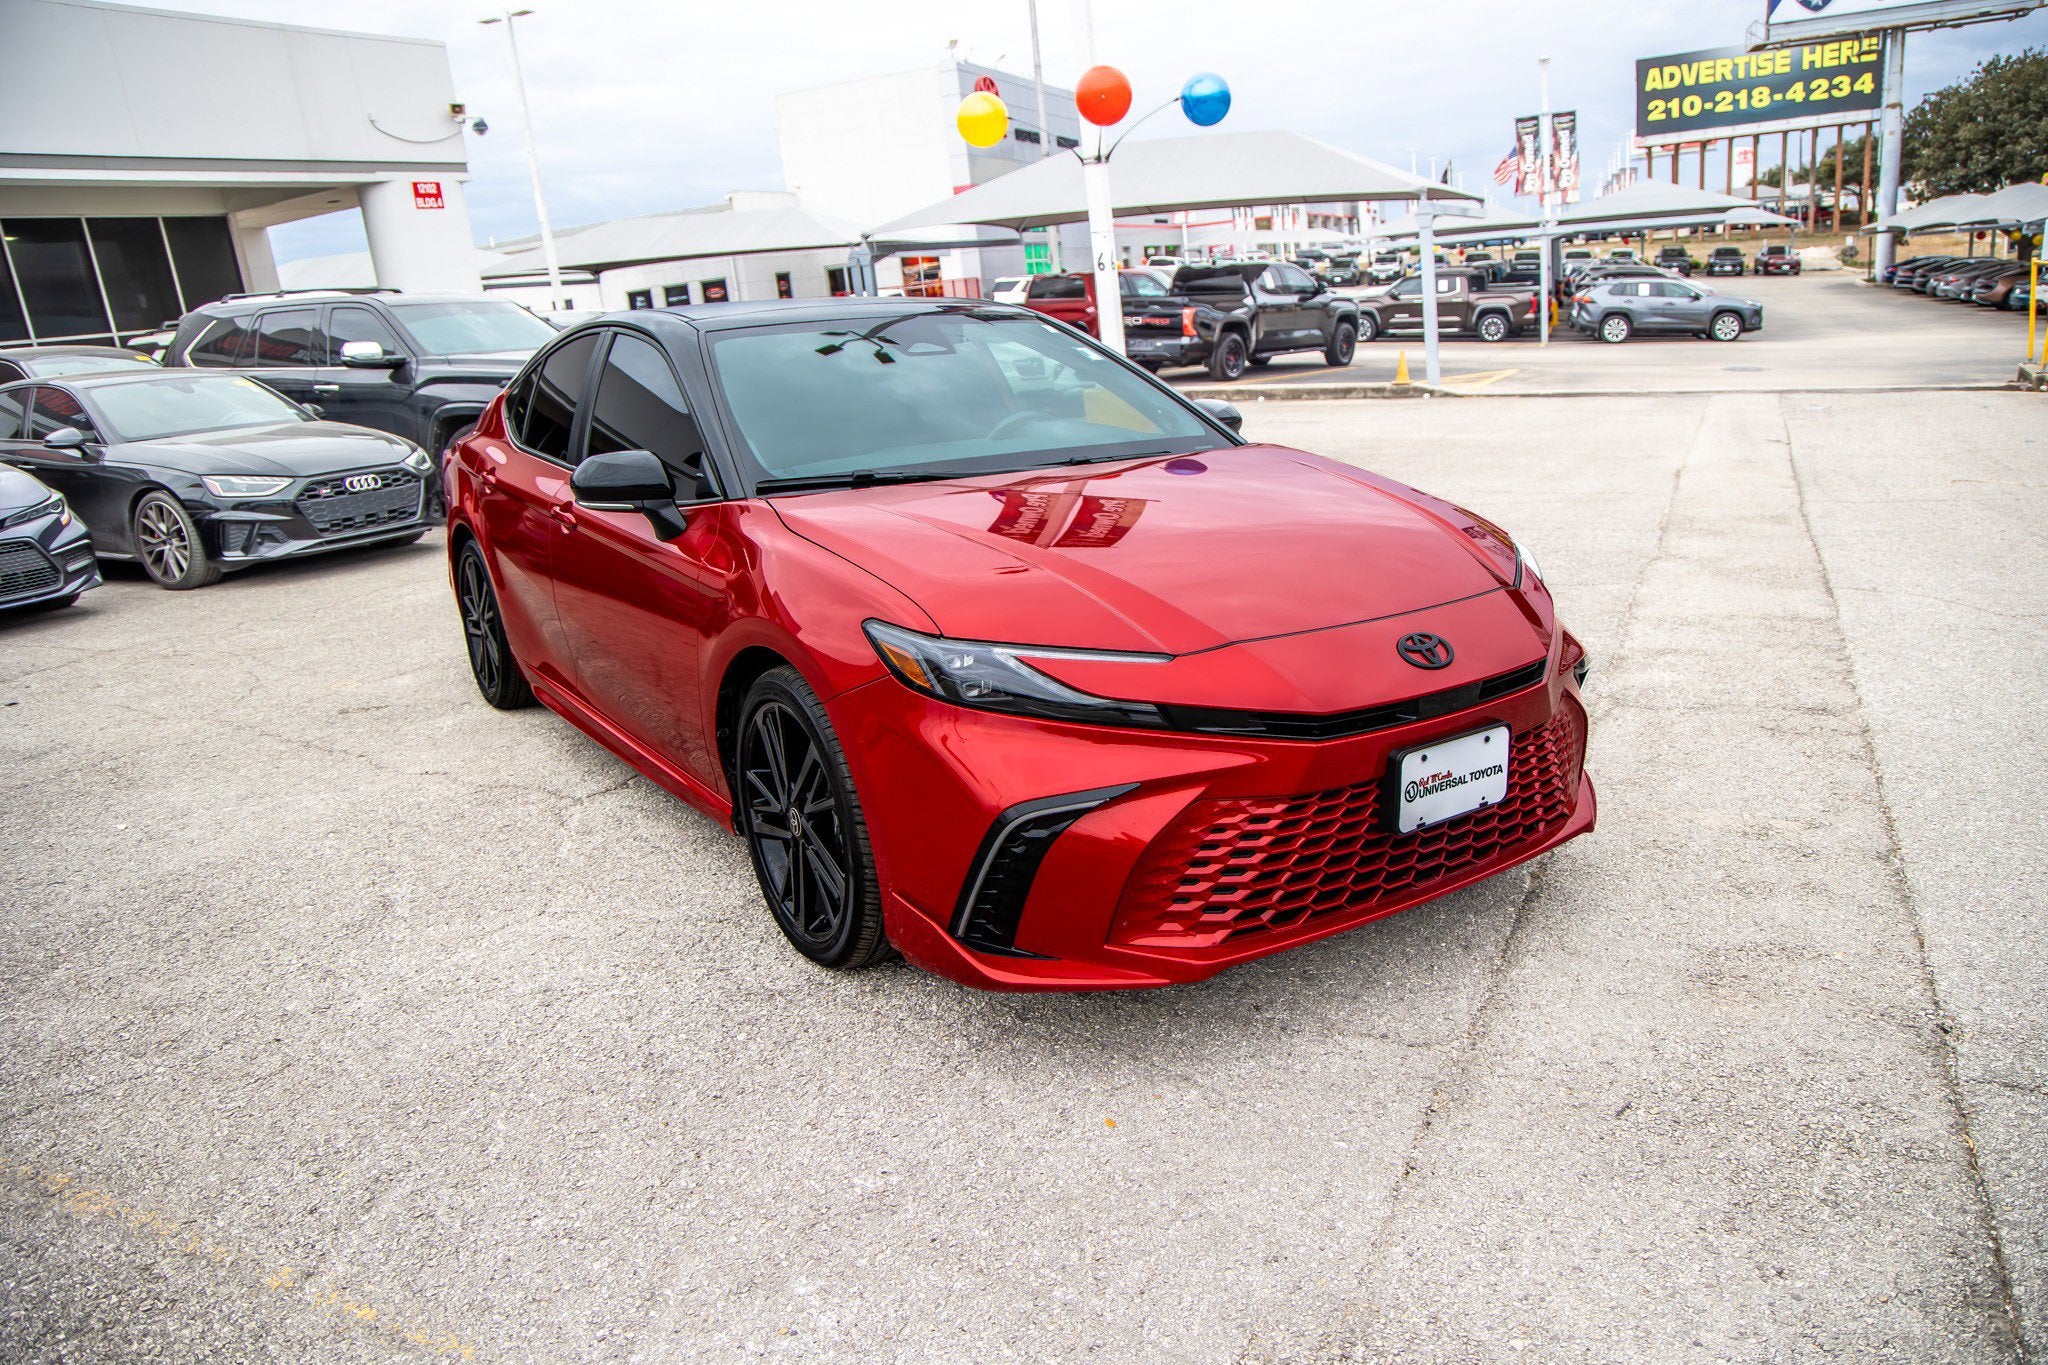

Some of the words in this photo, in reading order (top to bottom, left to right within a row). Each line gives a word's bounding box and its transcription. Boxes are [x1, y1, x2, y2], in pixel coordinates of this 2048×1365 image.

[1645, 49, 1791, 92] ADVERTISE
[1802, 37, 1879, 71] HERE
[1647, 72, 1875, 121] 210-218-4234
[1098, 252, 1105, 271] 6
[1418, 774, 1469, 798] UNIVERSAL
[1469, 764, 1504, 782] TOYOTA
